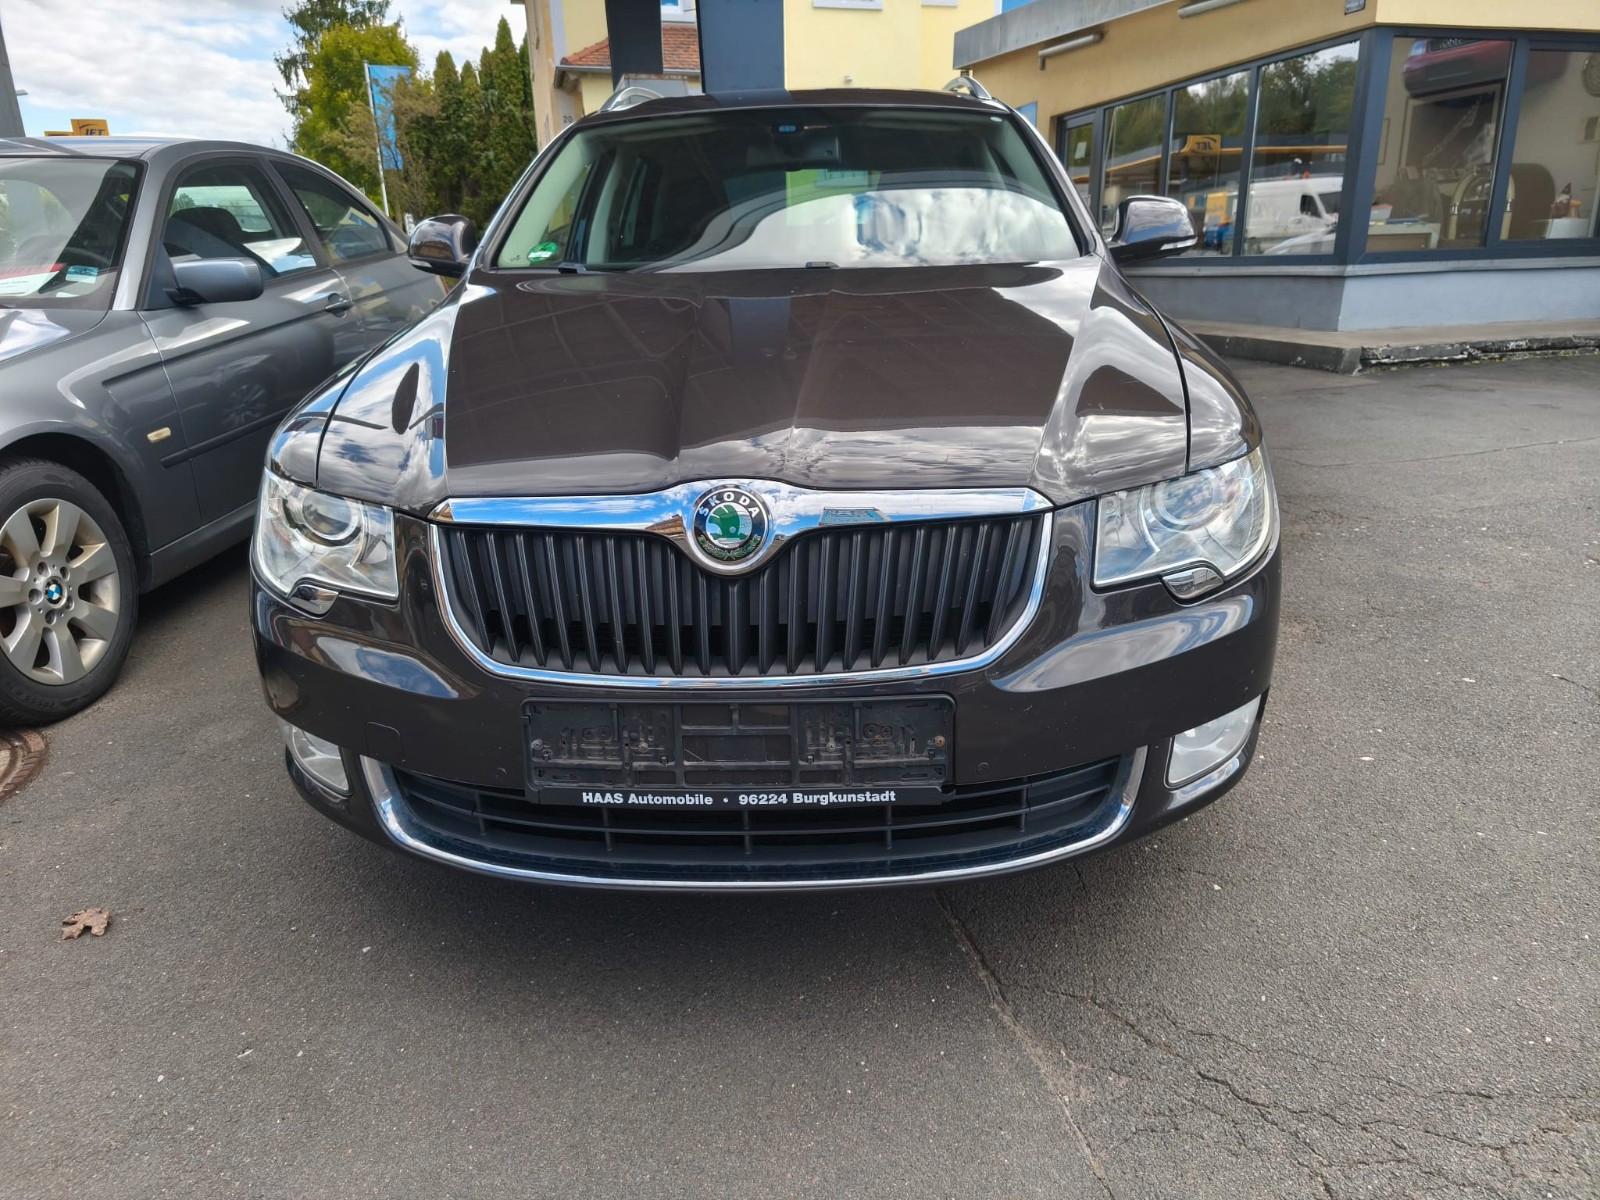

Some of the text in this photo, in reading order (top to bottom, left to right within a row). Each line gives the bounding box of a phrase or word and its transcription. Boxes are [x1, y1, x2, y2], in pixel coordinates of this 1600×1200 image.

[582, 790, 897, 805] HAAS Automobile 96224 Burgkunstadt
